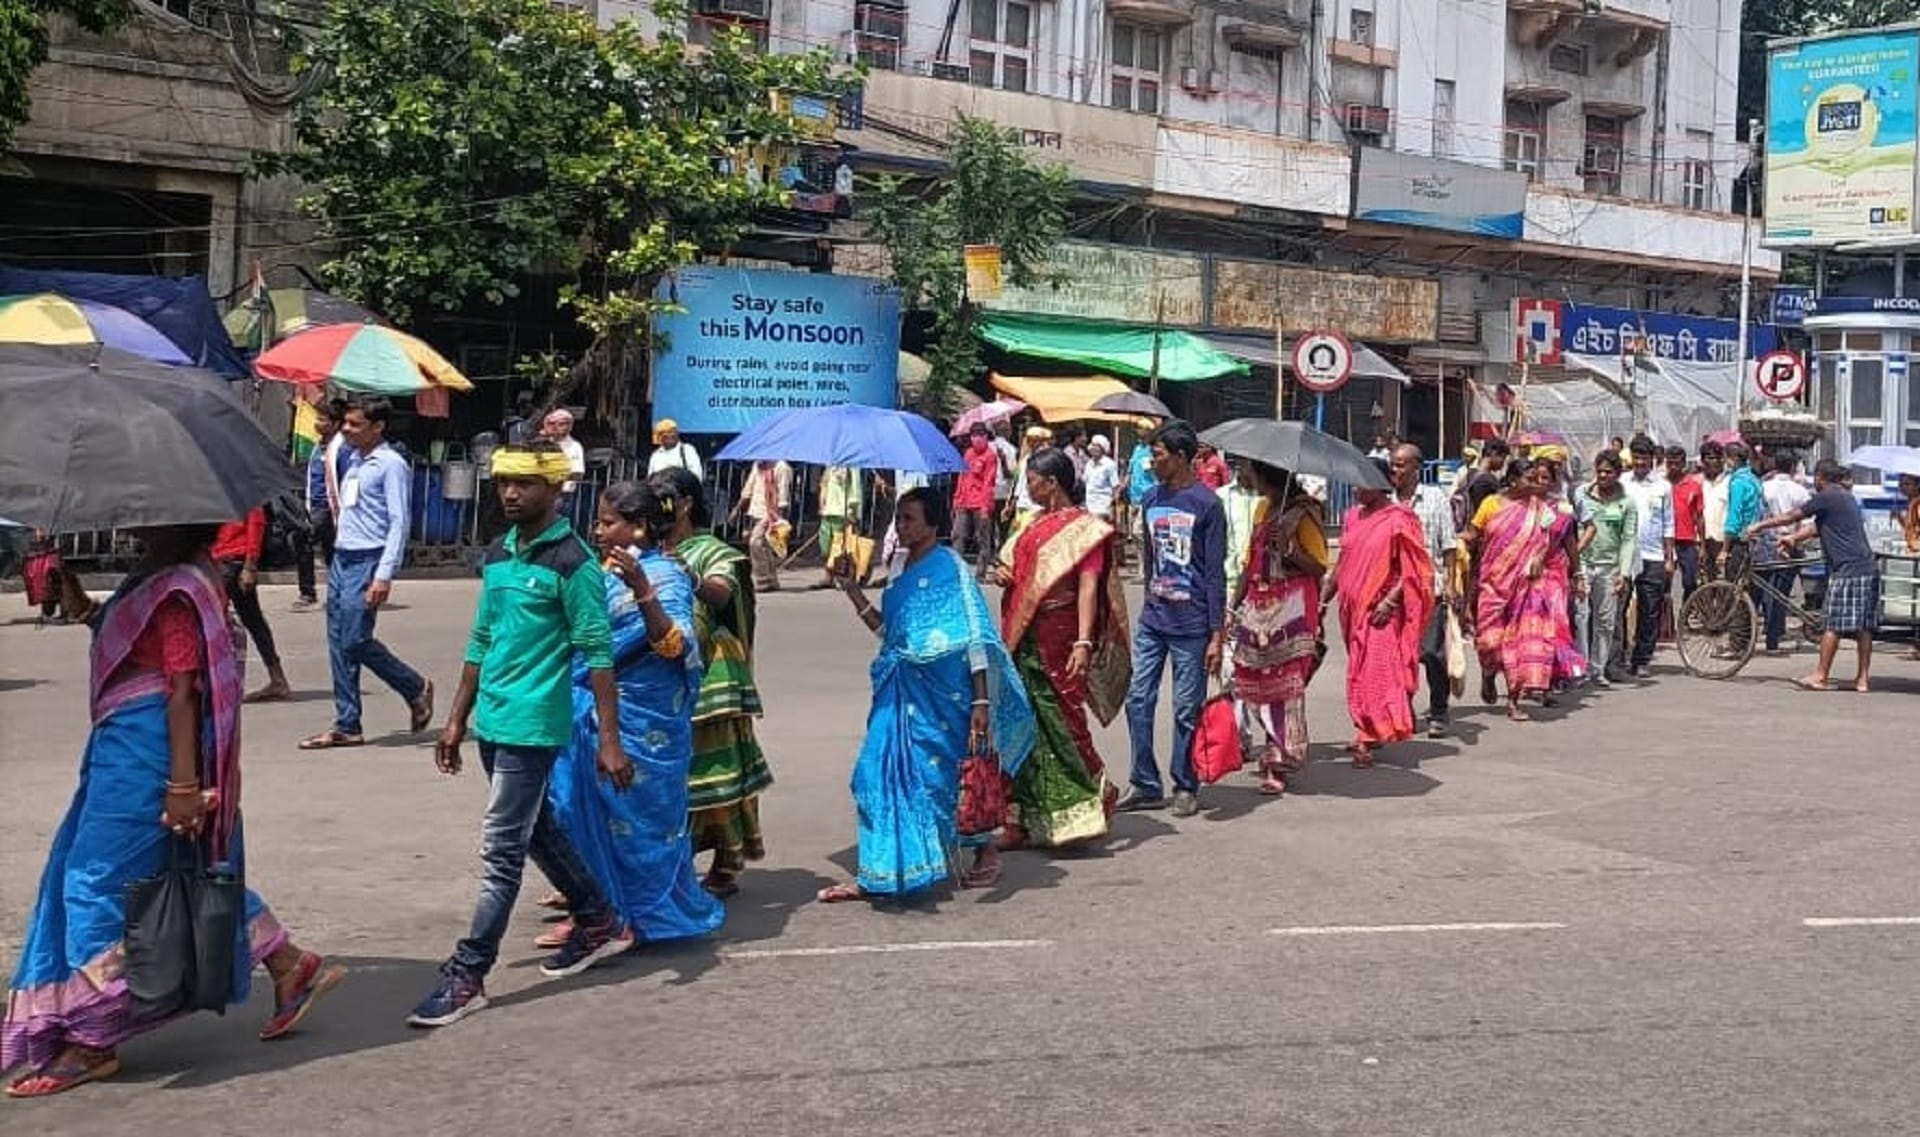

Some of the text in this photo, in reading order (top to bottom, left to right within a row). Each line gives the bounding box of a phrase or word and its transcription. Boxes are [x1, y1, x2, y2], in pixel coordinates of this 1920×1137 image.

[1886, 207, 1908, 222] LIC
[732, 293, 825, 315] Stay safe
[700, 318, 740, 337] this
[744, 316, 864, 345] Monsoon
[686, 355, 731, 371] During
[775, 358, 809, 372] avoid
[812, 359, 844, 374] going
[712, 377, 773, 390] electrical
[708, 395, 785, 408] distribution
